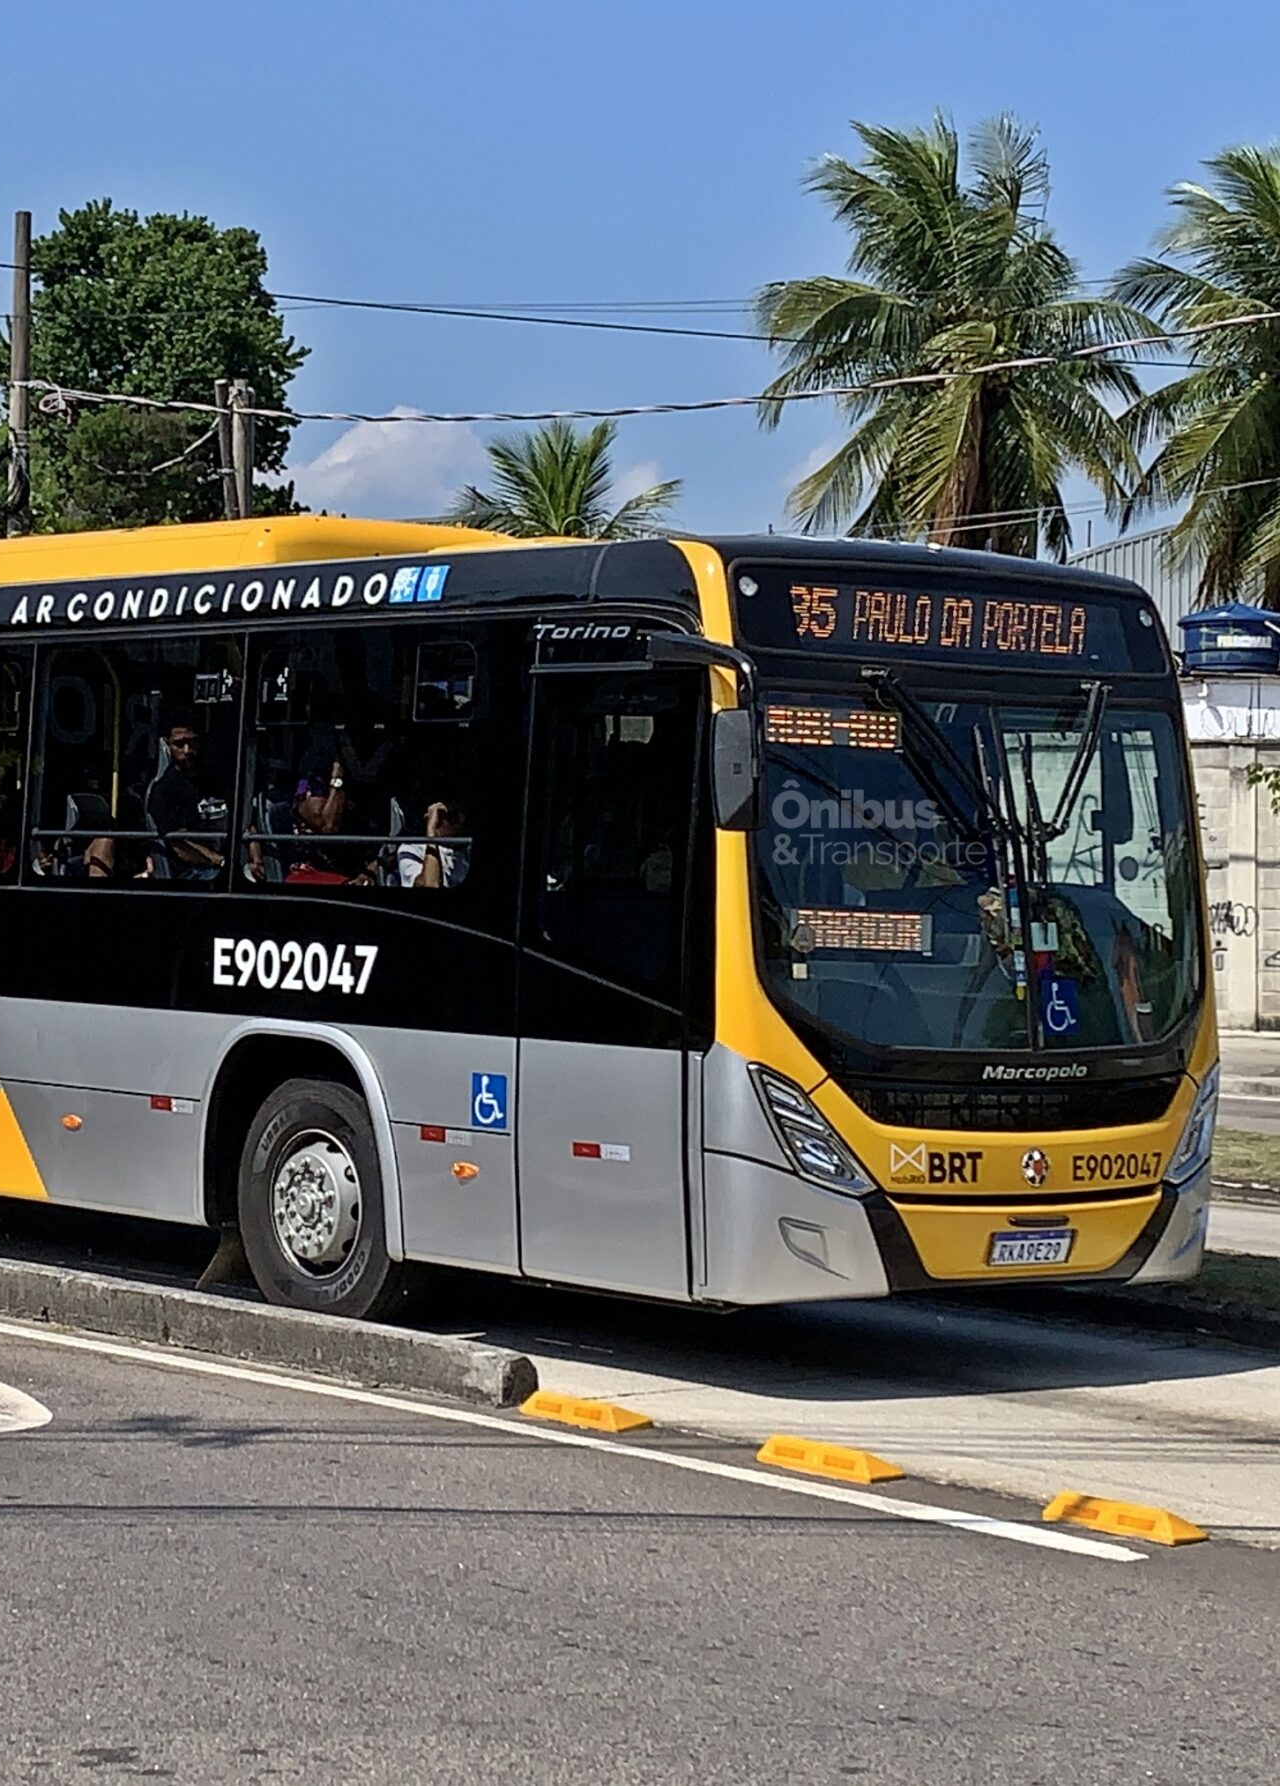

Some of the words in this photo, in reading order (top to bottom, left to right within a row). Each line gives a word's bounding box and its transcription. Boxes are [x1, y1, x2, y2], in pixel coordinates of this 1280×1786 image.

[11, 595, 52, 624] AR
[66, 573, 389, 622] CONDICIONADO
[533, 622, 631, 640] Torino
[853, 591, 931, 645] PAULO
[940, 597, 973, 648] DA
[982, 600, 1086, 655] PORTELA
[213, 937, 378, 995] E902047
[982, 1063, 1088, 1081] Marcopolo
[928, 1152, 983, 1183] BRT
[1073, 1152, 1162, 1181] E902047
[998, 1242, 1061, 1262] RKA9E29
